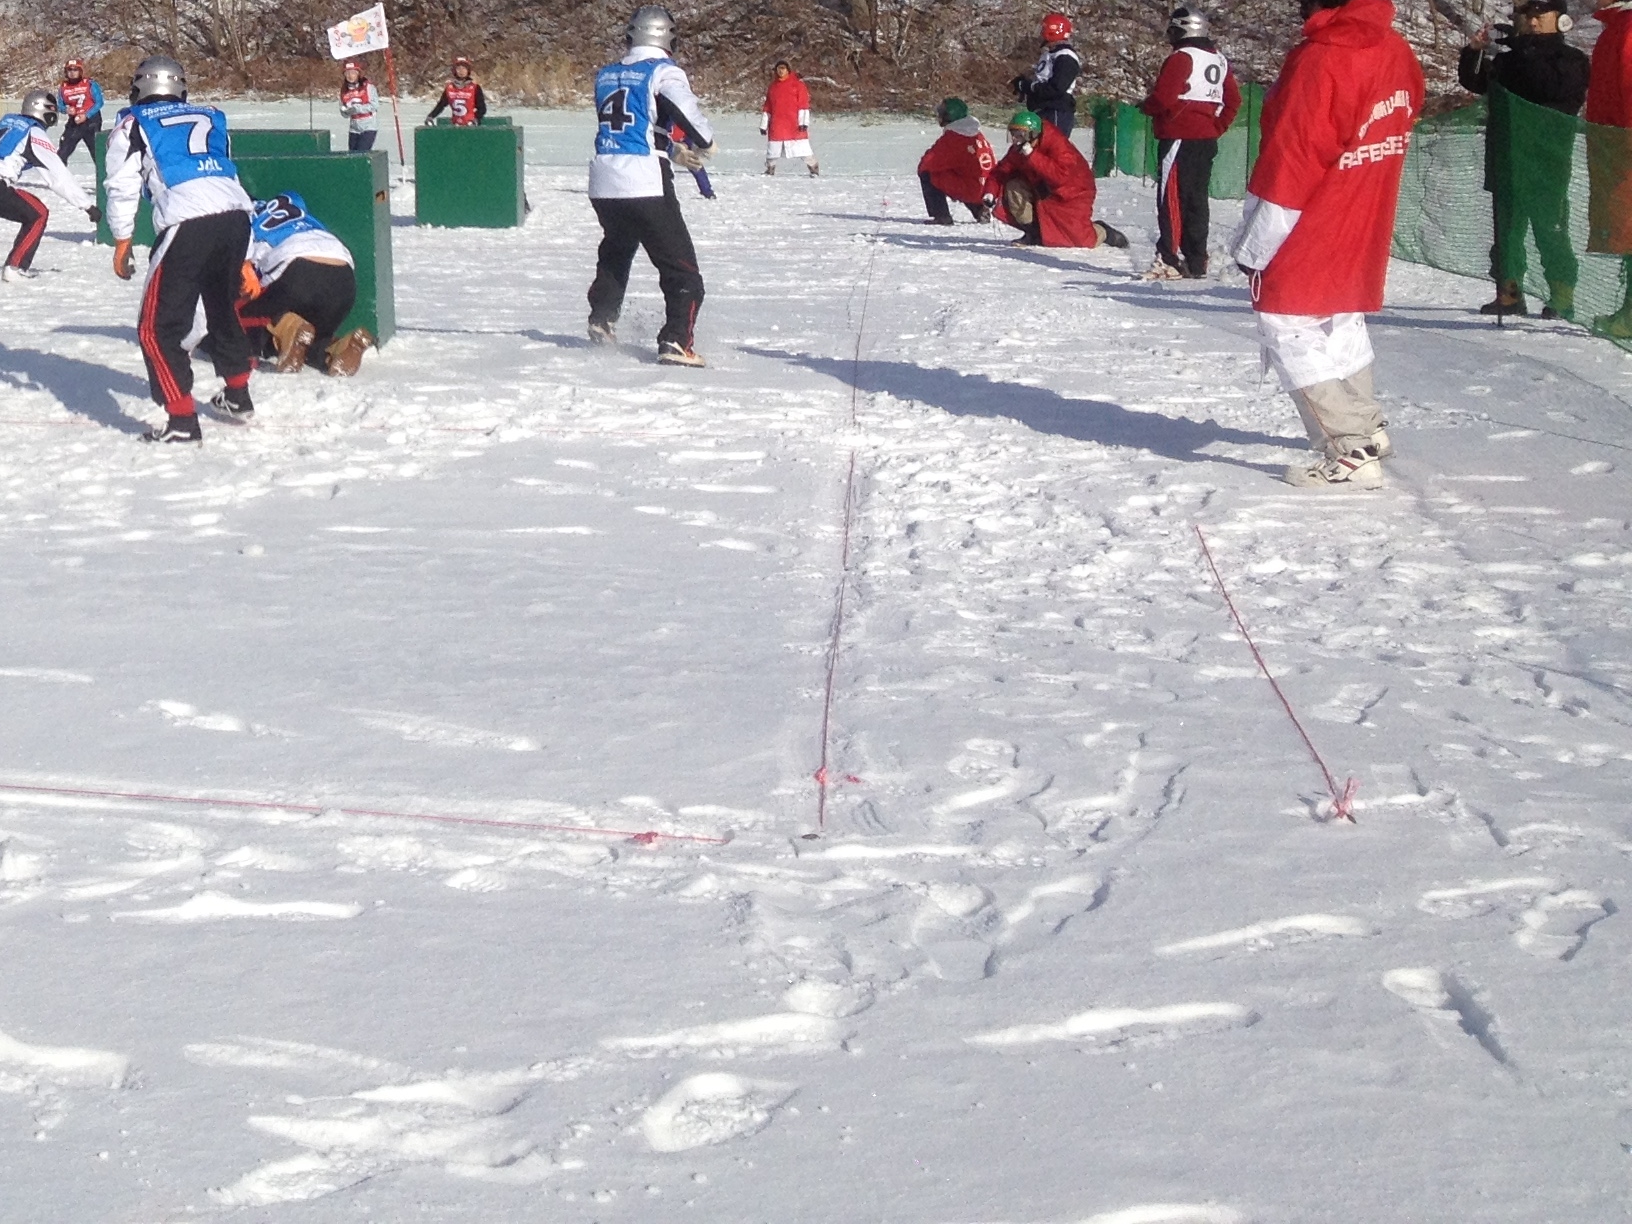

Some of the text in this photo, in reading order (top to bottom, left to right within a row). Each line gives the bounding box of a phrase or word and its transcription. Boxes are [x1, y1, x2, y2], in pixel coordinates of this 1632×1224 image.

[1204, 63, 1220, 85] 0
[452, 99, 468, 116] 5
[599, 87, 635, 133] 4
[159, 112, 215, 155] 7
[259, 194, 306, 231] 3
